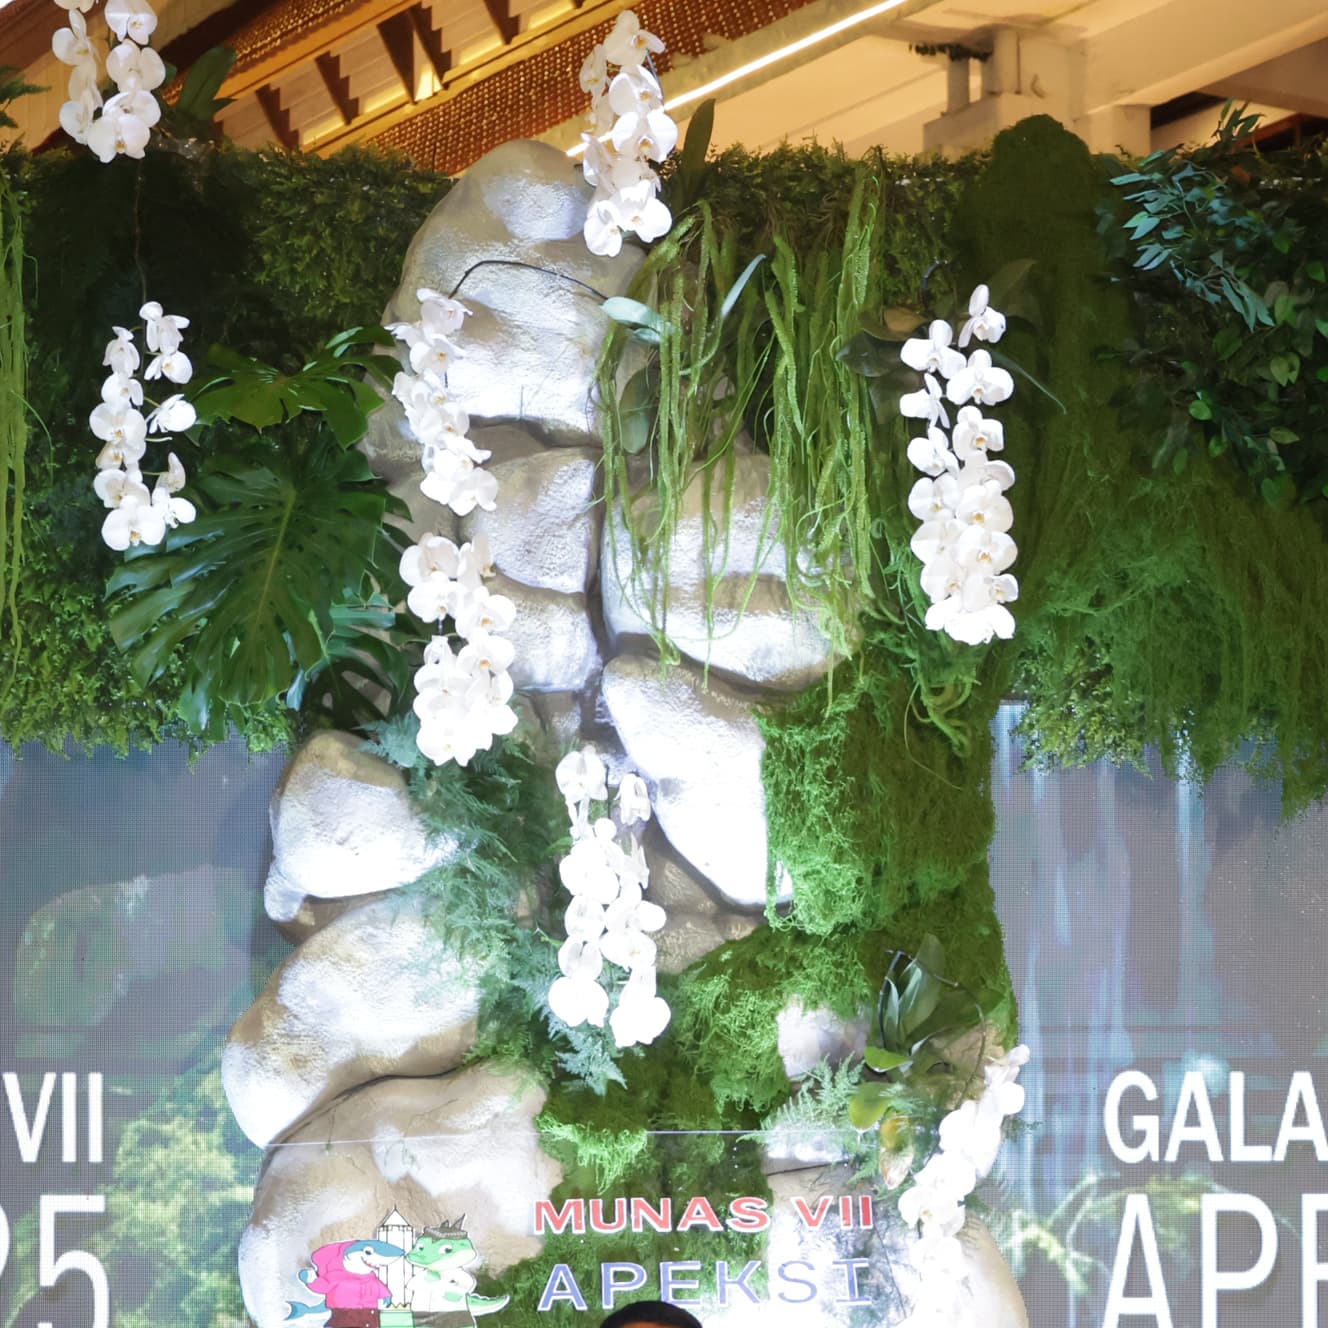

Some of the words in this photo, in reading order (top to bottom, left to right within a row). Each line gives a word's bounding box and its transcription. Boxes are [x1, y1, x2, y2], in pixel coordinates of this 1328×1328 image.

[3, 1070, 105, 1164] VII
[534, 1196, 771, 1235] MUNAS
[791, 1195, 873, 1231] VII
[536, 1257, 872, 1312] APEKSI
